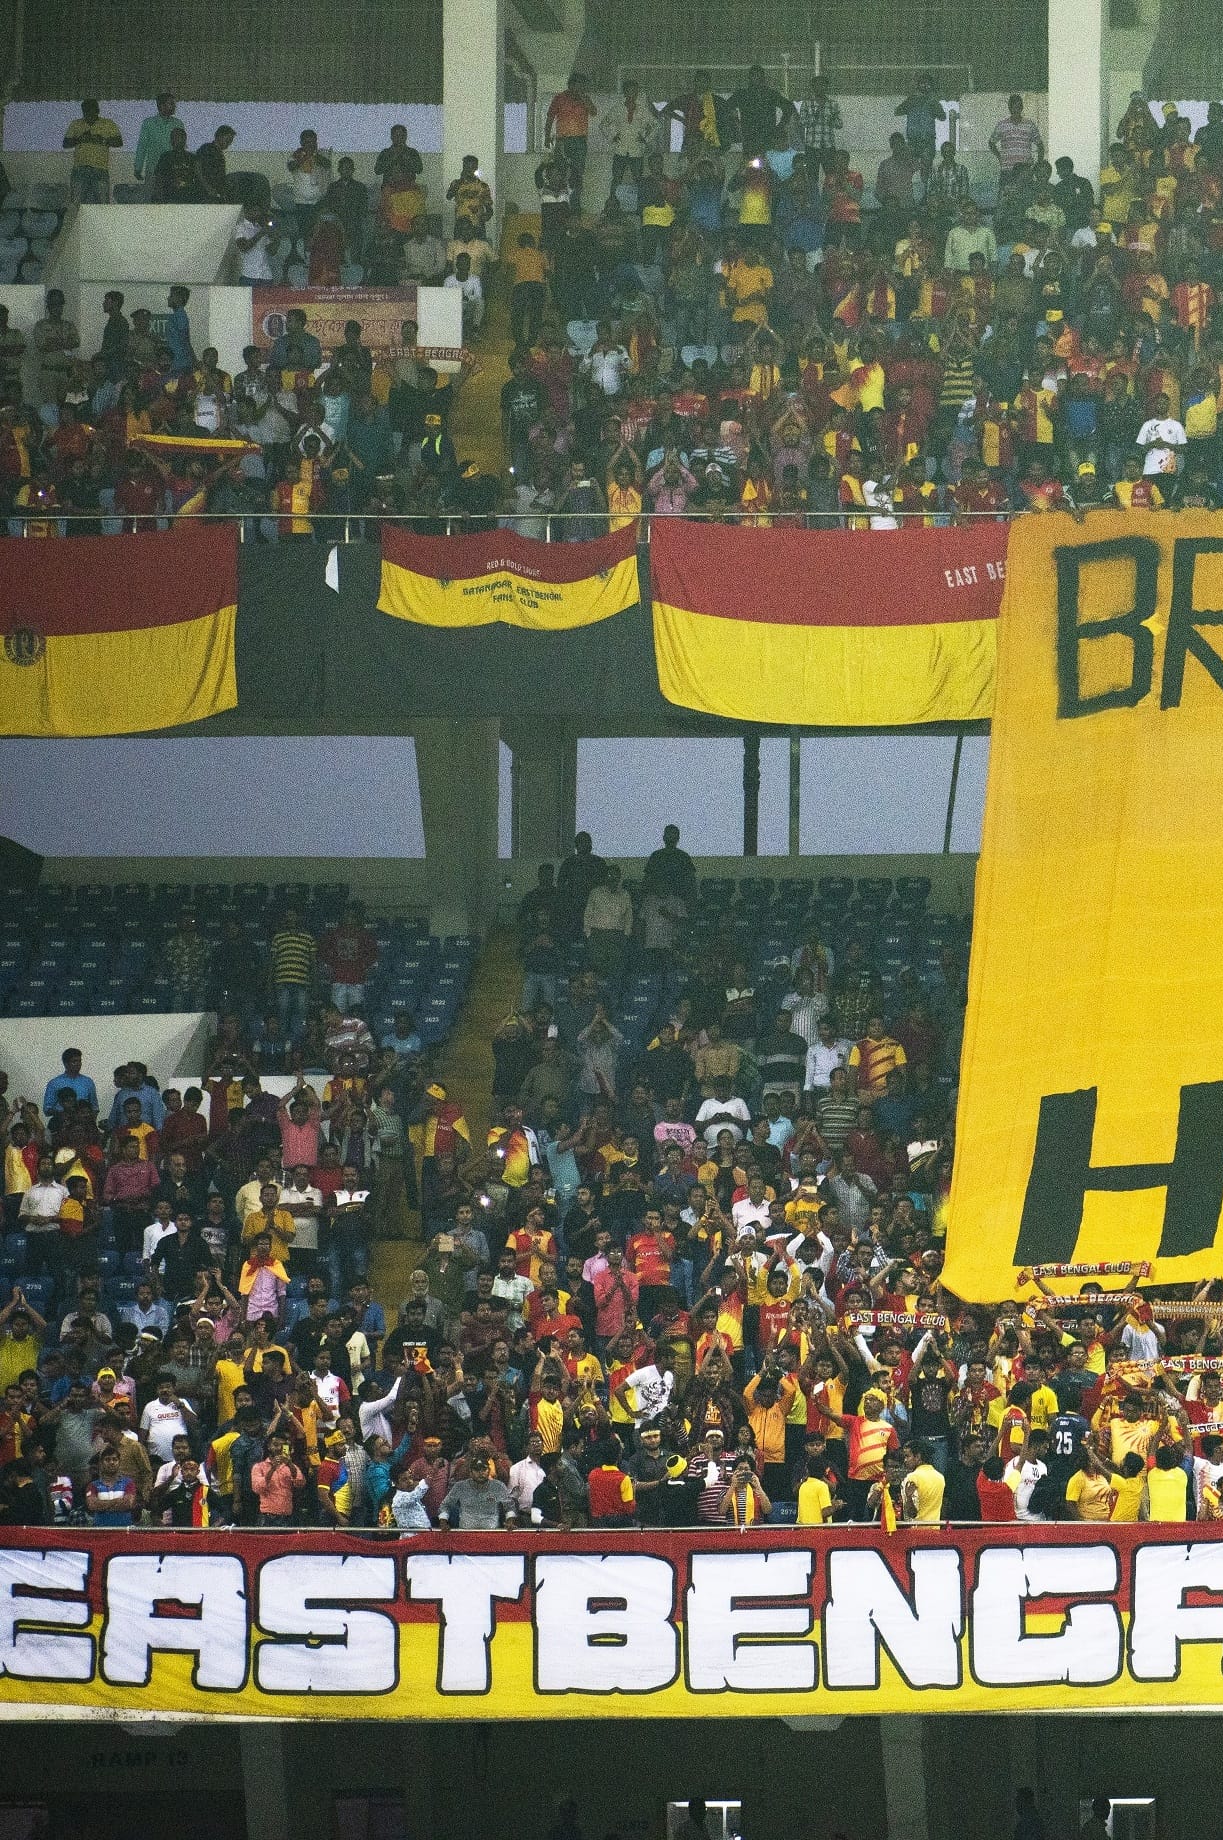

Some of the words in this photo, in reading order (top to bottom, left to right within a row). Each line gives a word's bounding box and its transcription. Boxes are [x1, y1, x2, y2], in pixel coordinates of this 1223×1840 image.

[486, 560, 499, 570] RED
[944, 566, 978, 588] EAST
[1033, 1264, 1058, 1277] EAST
[1060, 1263, 1101, 1275] BENGAL
[1104, 1261, 1131, 1273] CLUB
[1048, 1295, 1079, 1305] EAST
[1089, 1294, 1134, 1304] BENGAL
[850, 1313, 875, 1323] EAST
[877, 1313, 917, 1324] BENGAL
[920, 1315, 945, 1326] CLUB
[1162, 1359, 1187, 1370] EAST
[1055, 1431, 1073, 1455] 25
[90, 1751, 158, 1769] RAMP
[166, 1750, 190, 1767] 13
